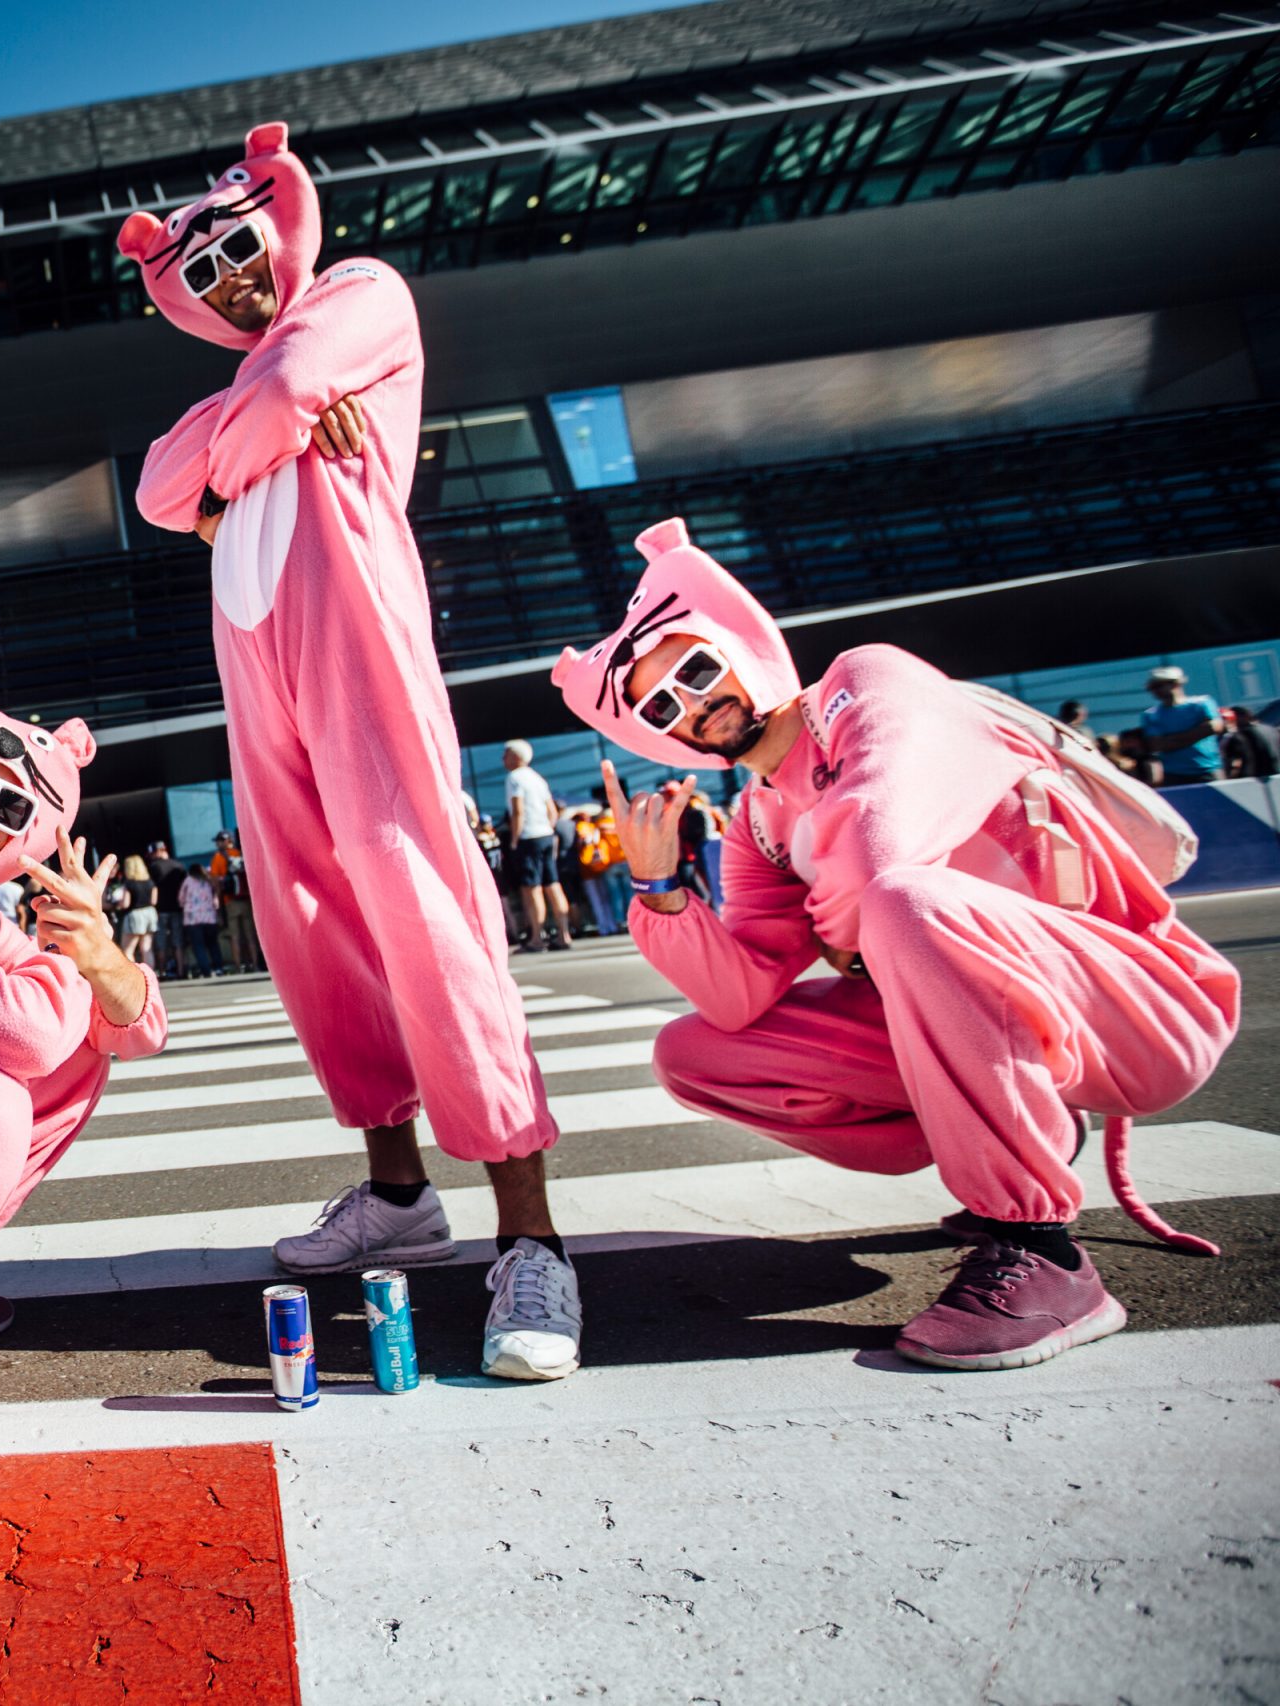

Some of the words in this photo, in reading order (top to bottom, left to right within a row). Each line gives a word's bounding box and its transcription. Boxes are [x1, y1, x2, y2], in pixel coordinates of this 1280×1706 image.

[279, 1335, 306, 1349] Red
[388, 1346, 402, 1368] Bull
[393, 1369, 405, 1391] Red
